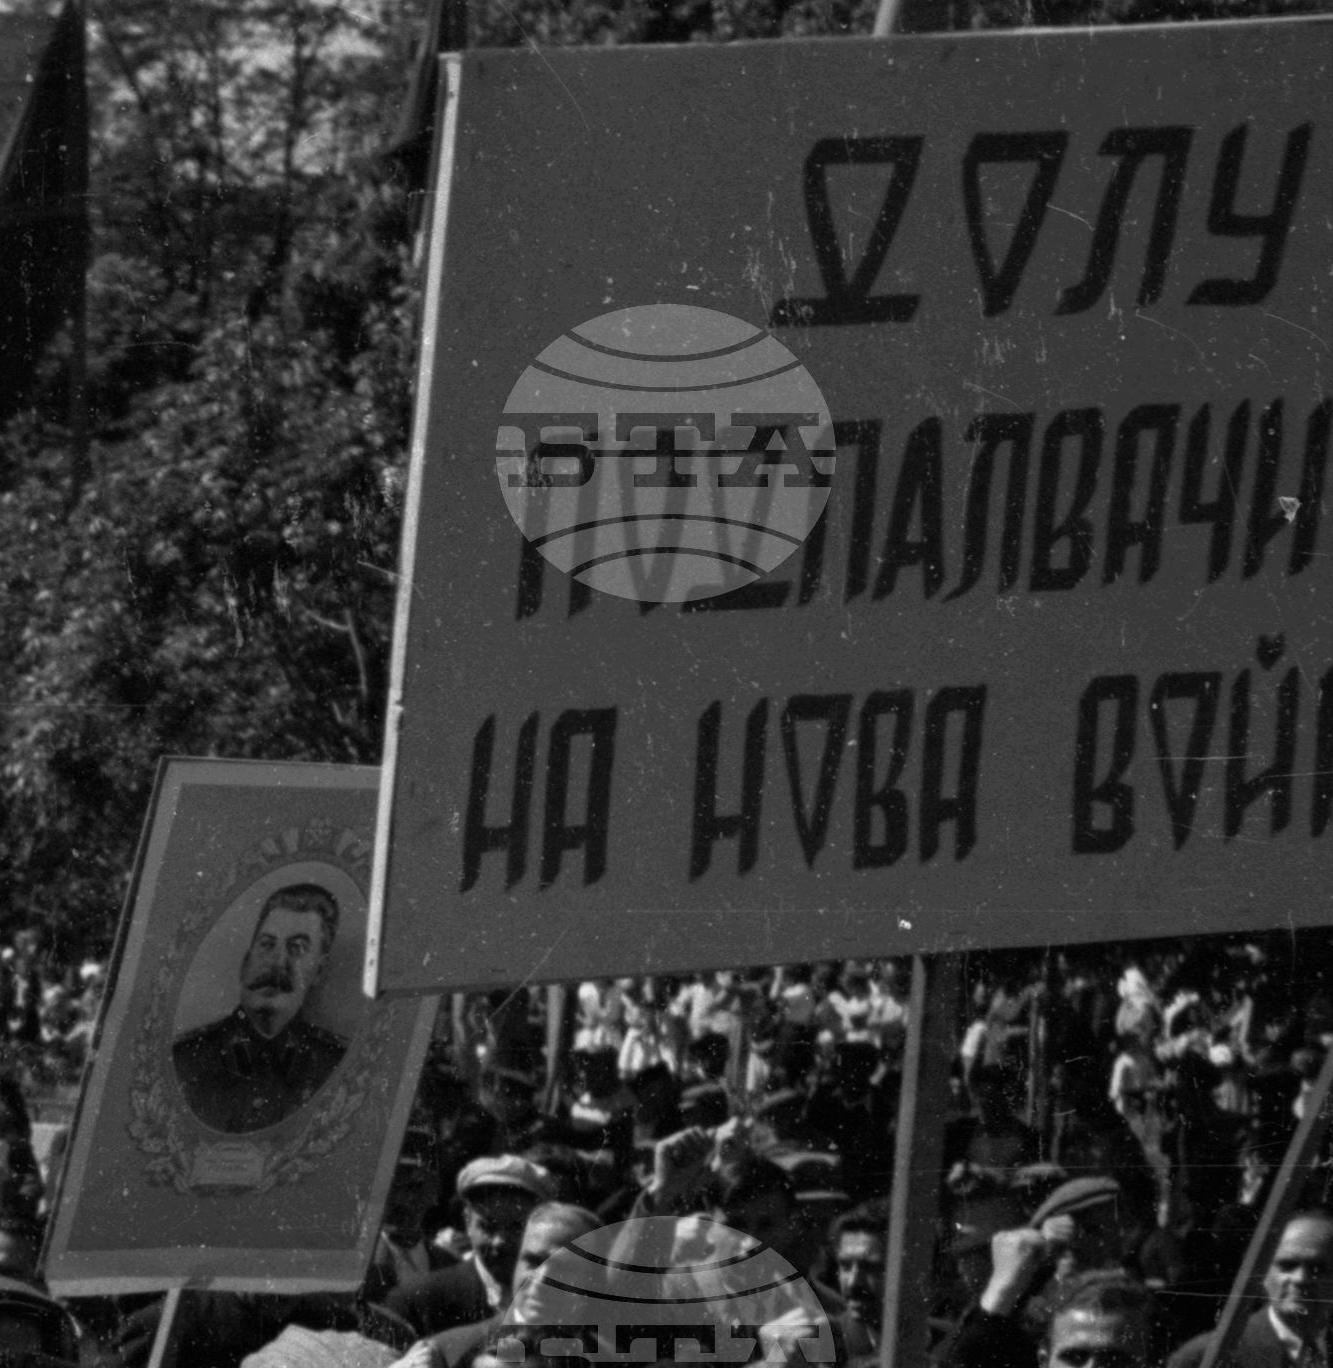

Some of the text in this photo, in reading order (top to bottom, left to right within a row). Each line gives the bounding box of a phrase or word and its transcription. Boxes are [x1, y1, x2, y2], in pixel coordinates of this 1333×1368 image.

[769, 121, 1314, 328] ДОЛУ
[459, 705, 618, 894] НА
[688, 684, 987, 884] НОВА
